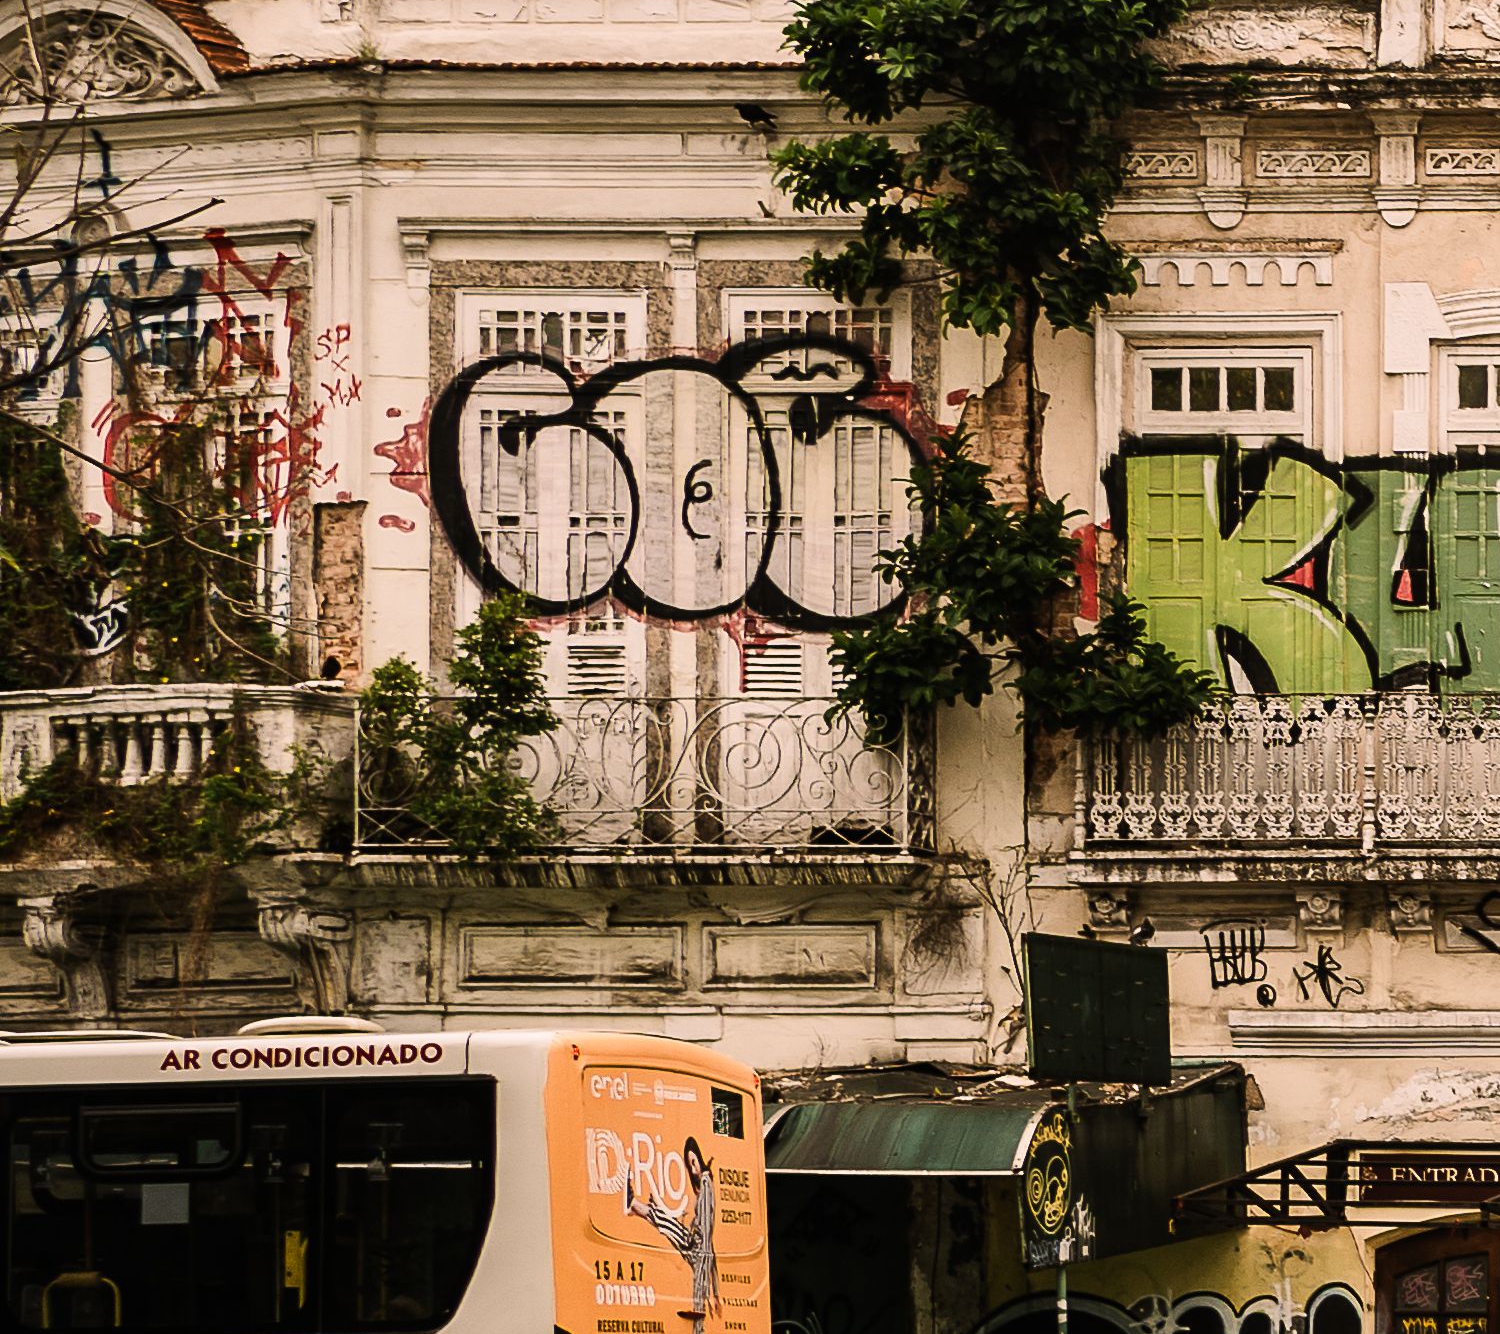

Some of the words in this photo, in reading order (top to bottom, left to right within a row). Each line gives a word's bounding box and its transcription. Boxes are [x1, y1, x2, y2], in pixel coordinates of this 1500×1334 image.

[160, 1049, 201, 1070] AR
[211, 1042, 443, 1070] CONDICIONADO
[591, 1072, 630, 1100] enel
[718, 1168, 750, 1188] DISQUE
[595, 1260, 611, 1281] 15
[616, 1261, 625, 1281] A
[630, 1262, 645, 1282] 17
[595, 1284, 657, 1307] OUTUBRO
[597, 1319, 631, 1334] RESERVA
[631, 1320, 665, 1334] CULTURAL
